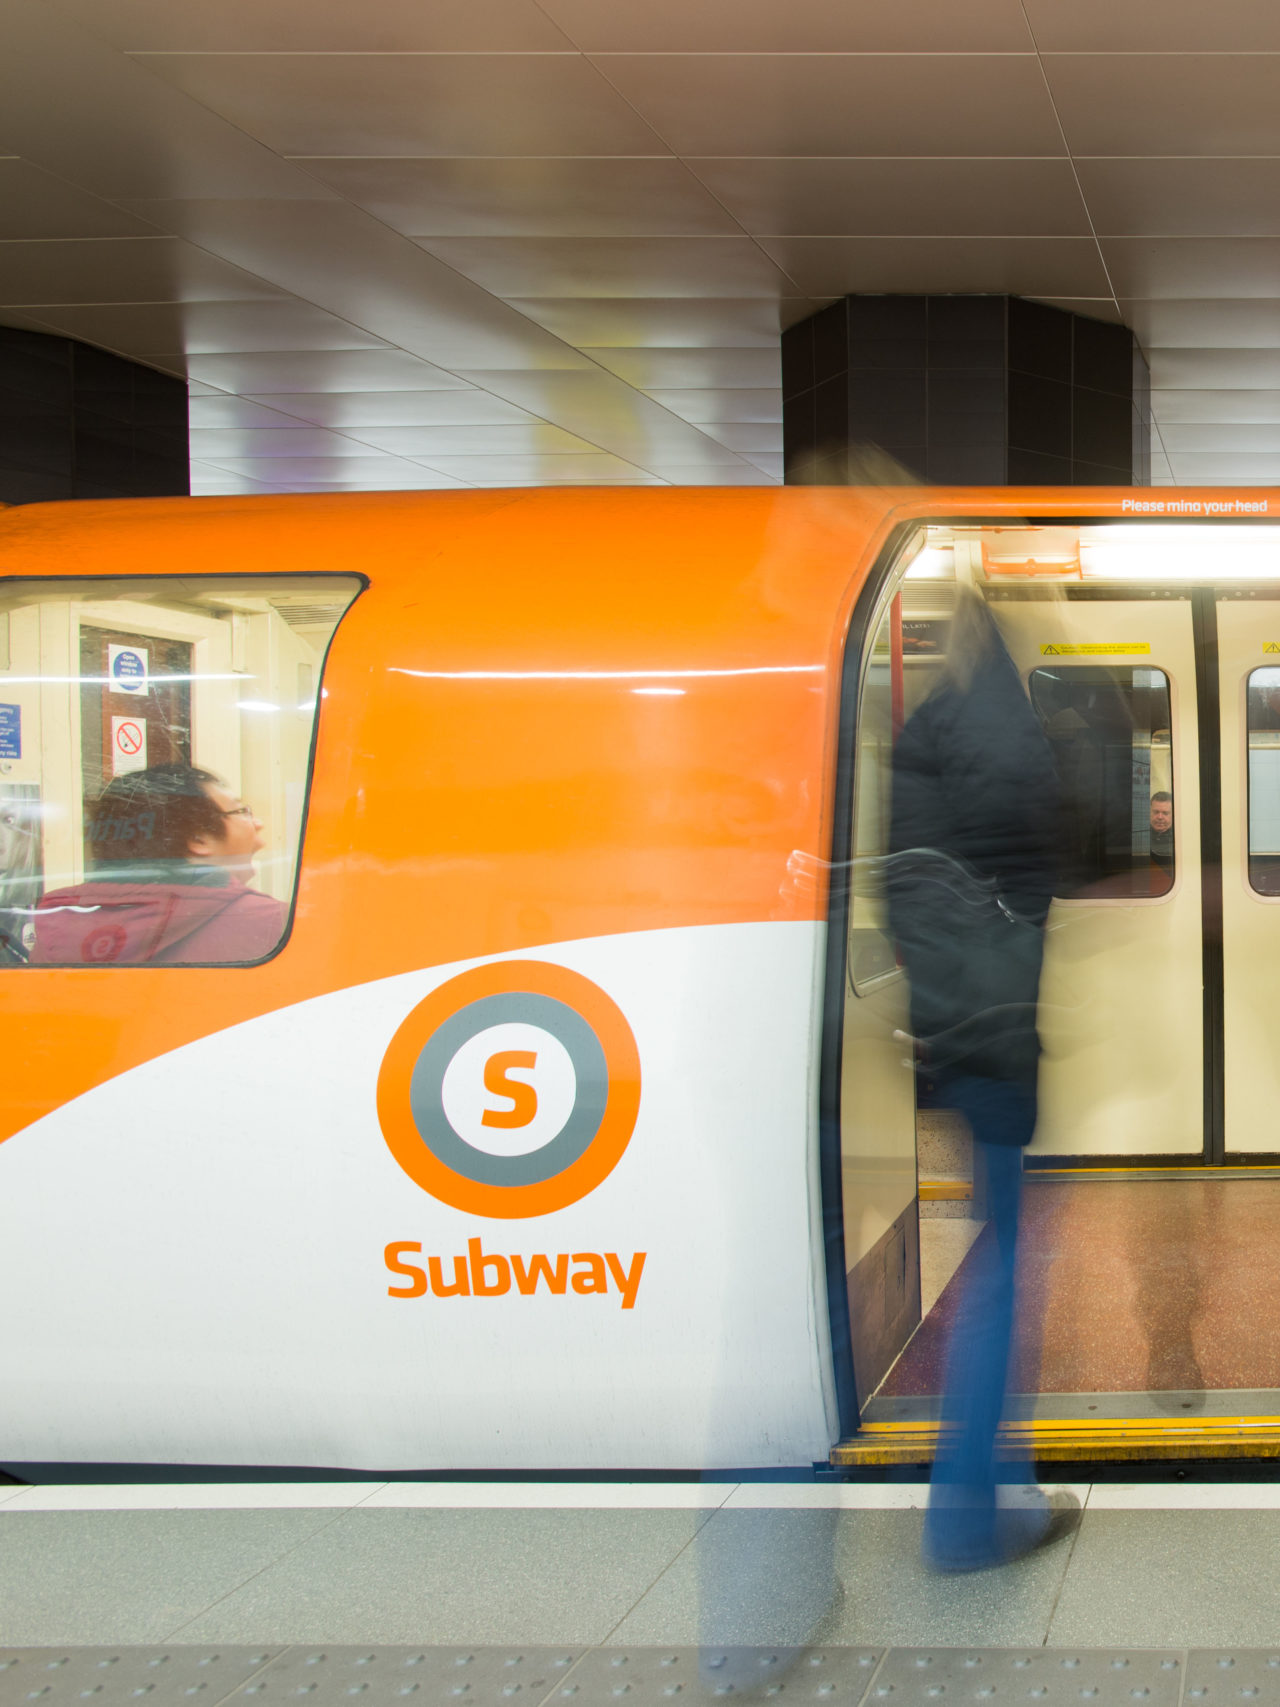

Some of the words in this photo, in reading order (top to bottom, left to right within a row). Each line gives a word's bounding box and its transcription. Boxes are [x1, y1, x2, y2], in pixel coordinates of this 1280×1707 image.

[1122, 499, 1165, 512] Please
[1203, 502, 1233, 516] your
[1235, 499, 1268, 512] head
[481, 1050, 538, 1129] S
[383, 1236, 648, 1310] Subway
